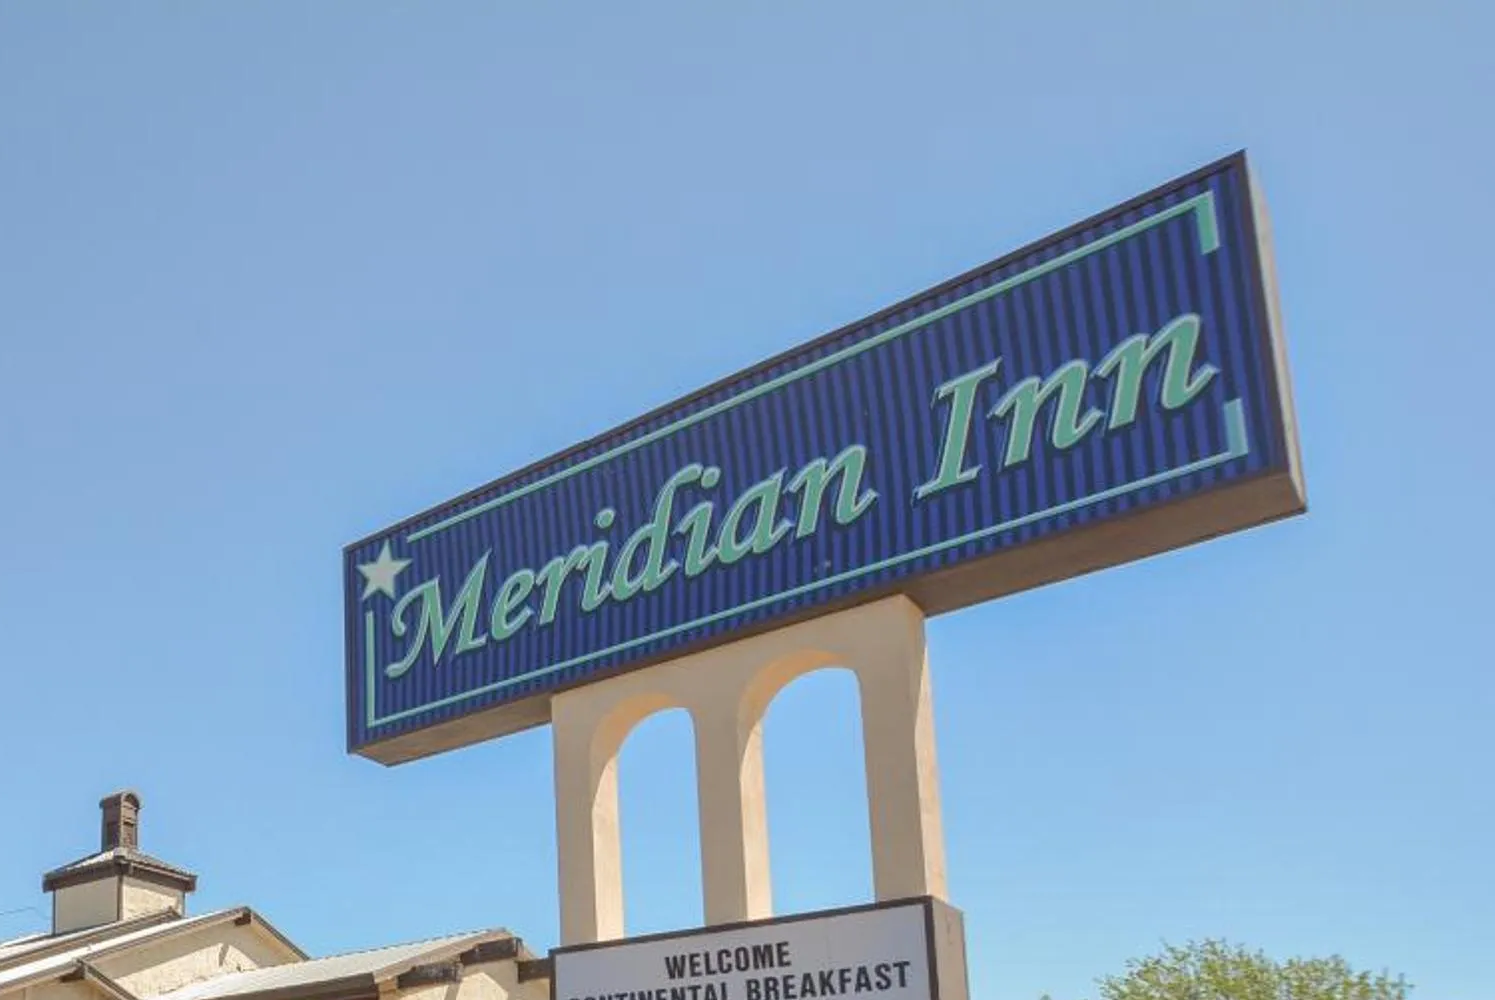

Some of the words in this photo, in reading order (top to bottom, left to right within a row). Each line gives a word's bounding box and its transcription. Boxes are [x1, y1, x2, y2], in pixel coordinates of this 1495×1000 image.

[386, 444, 878, 678] Meridian
[913, 312, 1219, 502] Inn
[665, 941, 792, 979] WELCOME
